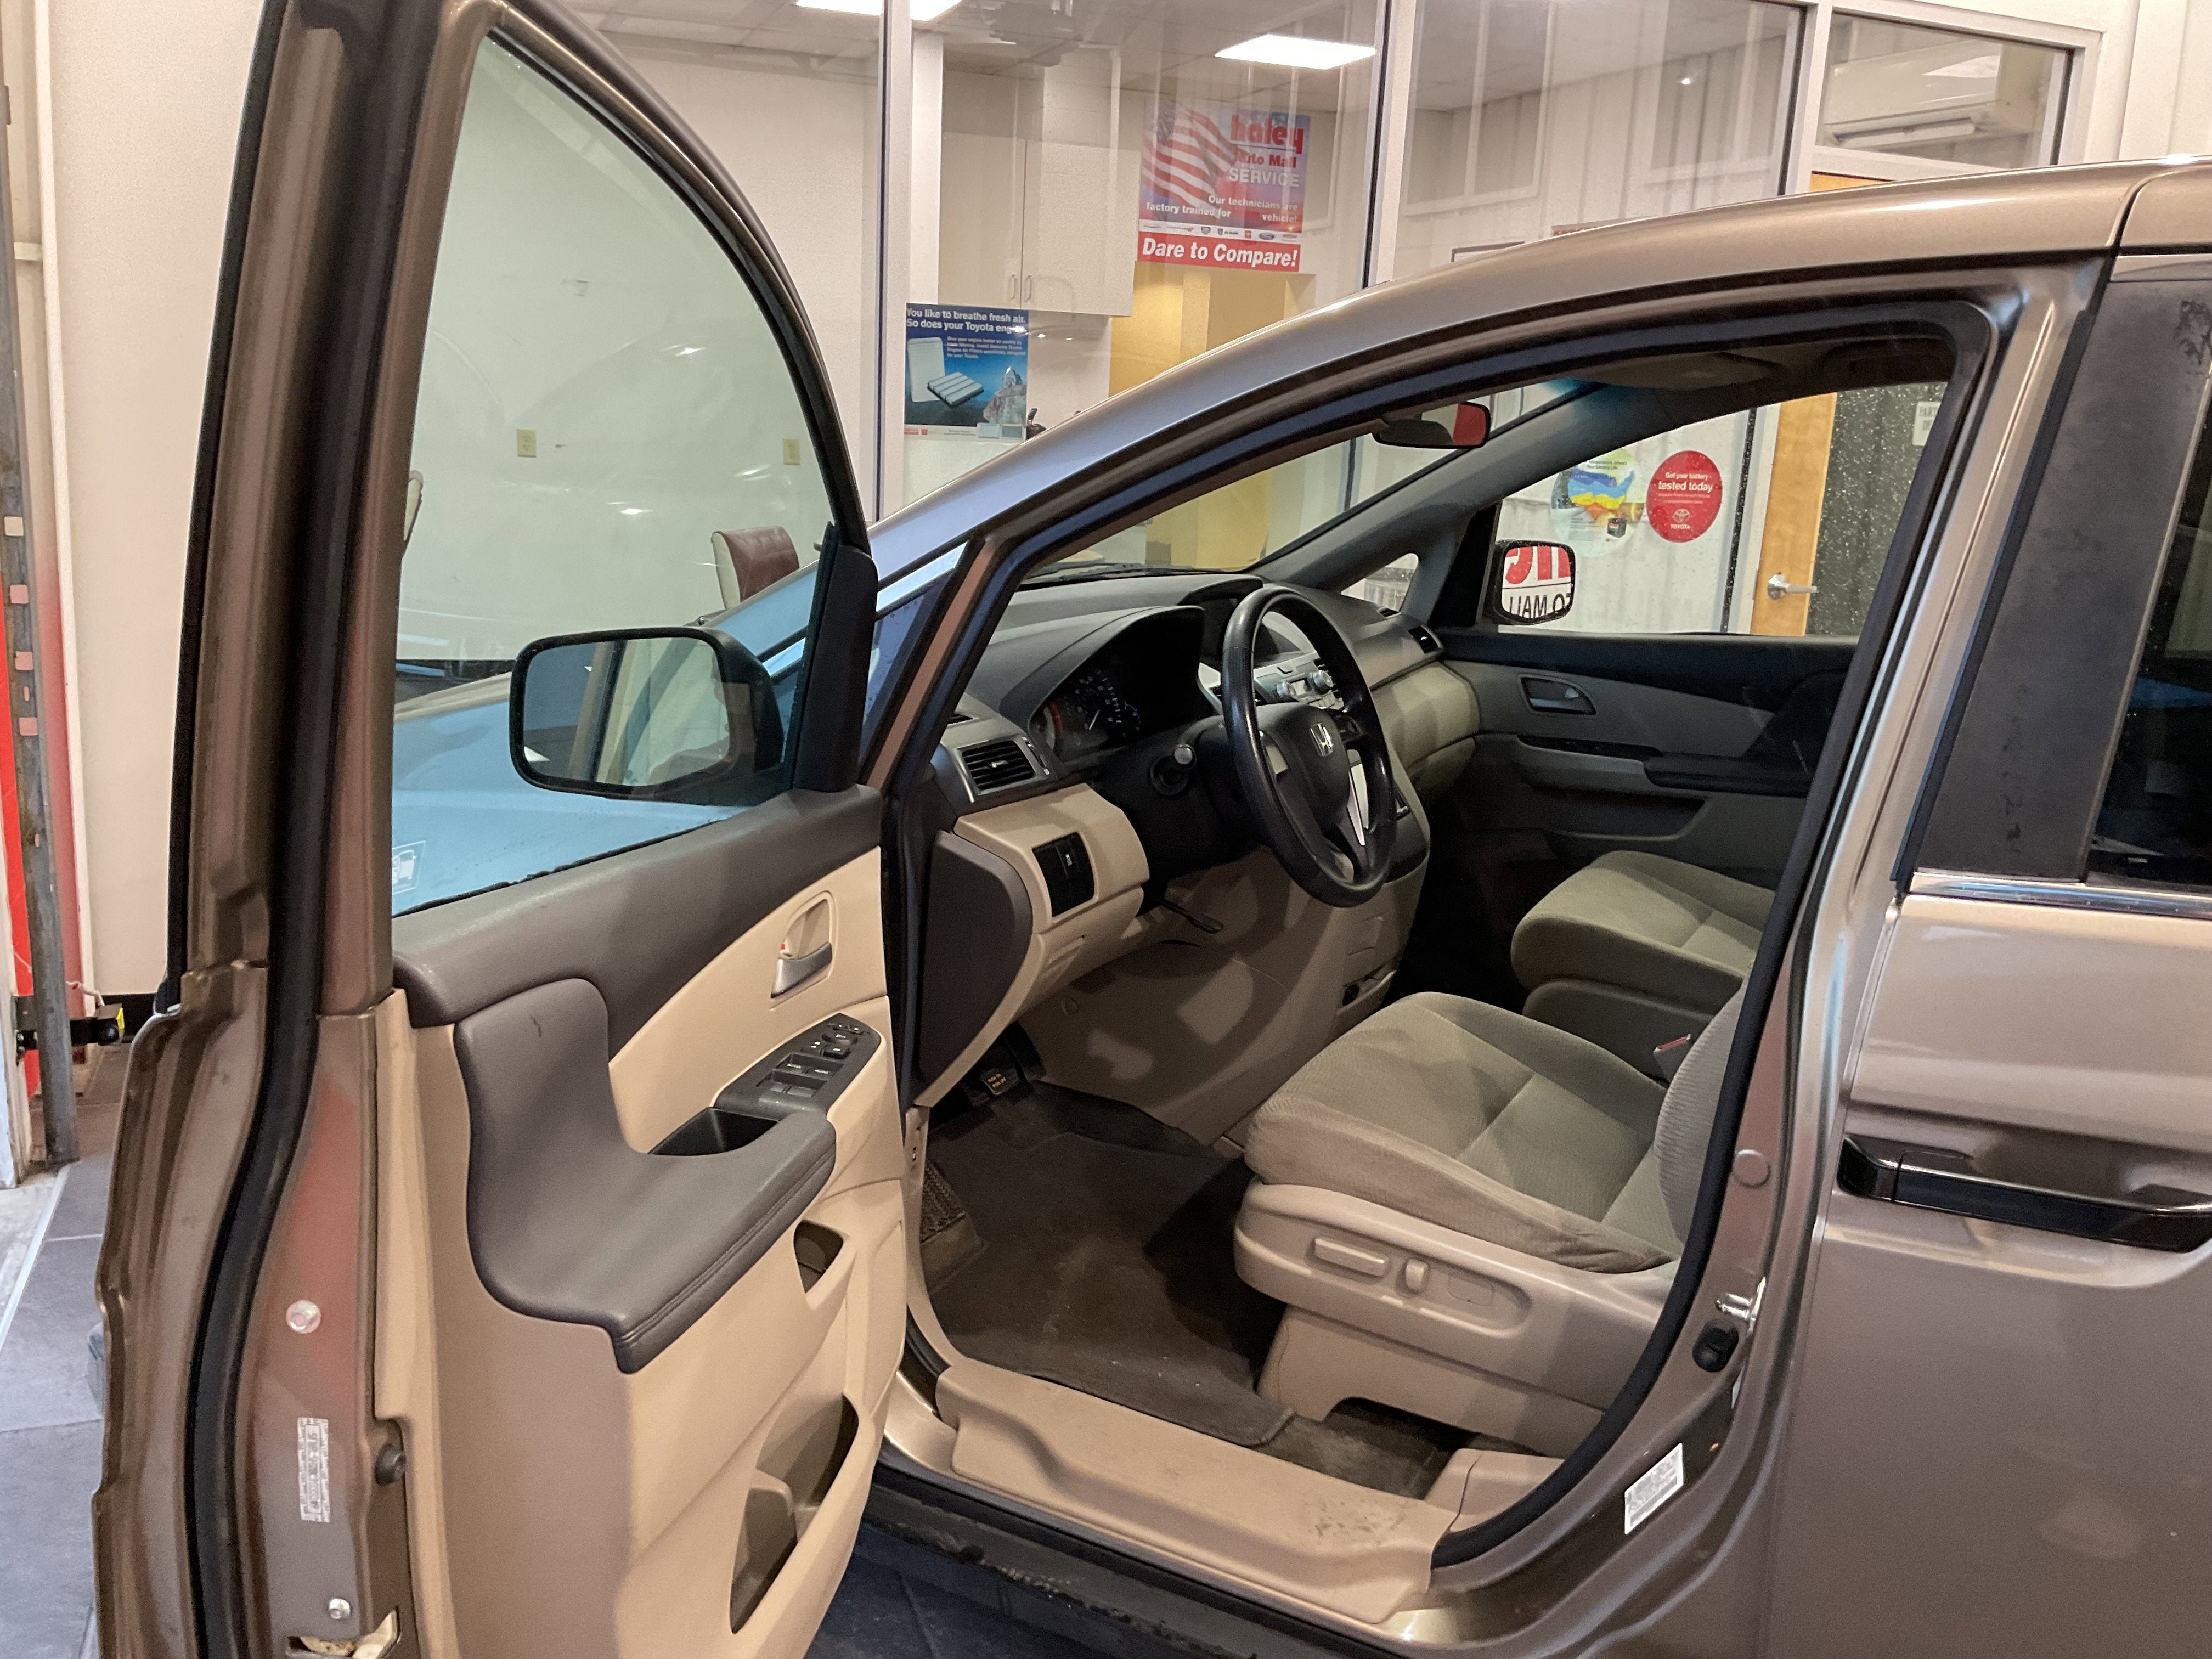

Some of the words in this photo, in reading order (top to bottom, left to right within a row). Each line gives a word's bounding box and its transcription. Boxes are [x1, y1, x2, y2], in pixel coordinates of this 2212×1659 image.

[1231, 114, 1304, 155] haley
[1269, 154, 1296, 168] Mall
[1226, 167, 1300, 188] SERVICE
[1209, 195, 1225, 204] Our
[1228, 197, 1280, 209] technicians
[1147, 202, 1180, 214] factory
[1182, 205, 1215, 216] trained
[1218, 208, 1232, 217] for
[1262, 213, 1297, 223] vehicle!
[1142, 238, 1185, 257] Dare
[1190, 242, 1209, 259] to
[1214, 243, 1298, 268] Compare!
[906, 308, 922, 317] You
[924, 309, 940, 318] like
[943, 310, 951, 319] to
[953, 311, 987, 321] breathe
[989, 313, 1010, 322] fresh
[1013, 314, 1026, 323] air.
[906, 318, 918, 327] So
[921, 319, 942, 329] does
[944, 321, 963, 330] your
[965, 321, 994, 332] Toyota
[1689, 473, 1708, 481] battery
[1658, 481, 1687, 491] tested
[1689, 481, 1713, 493] today
